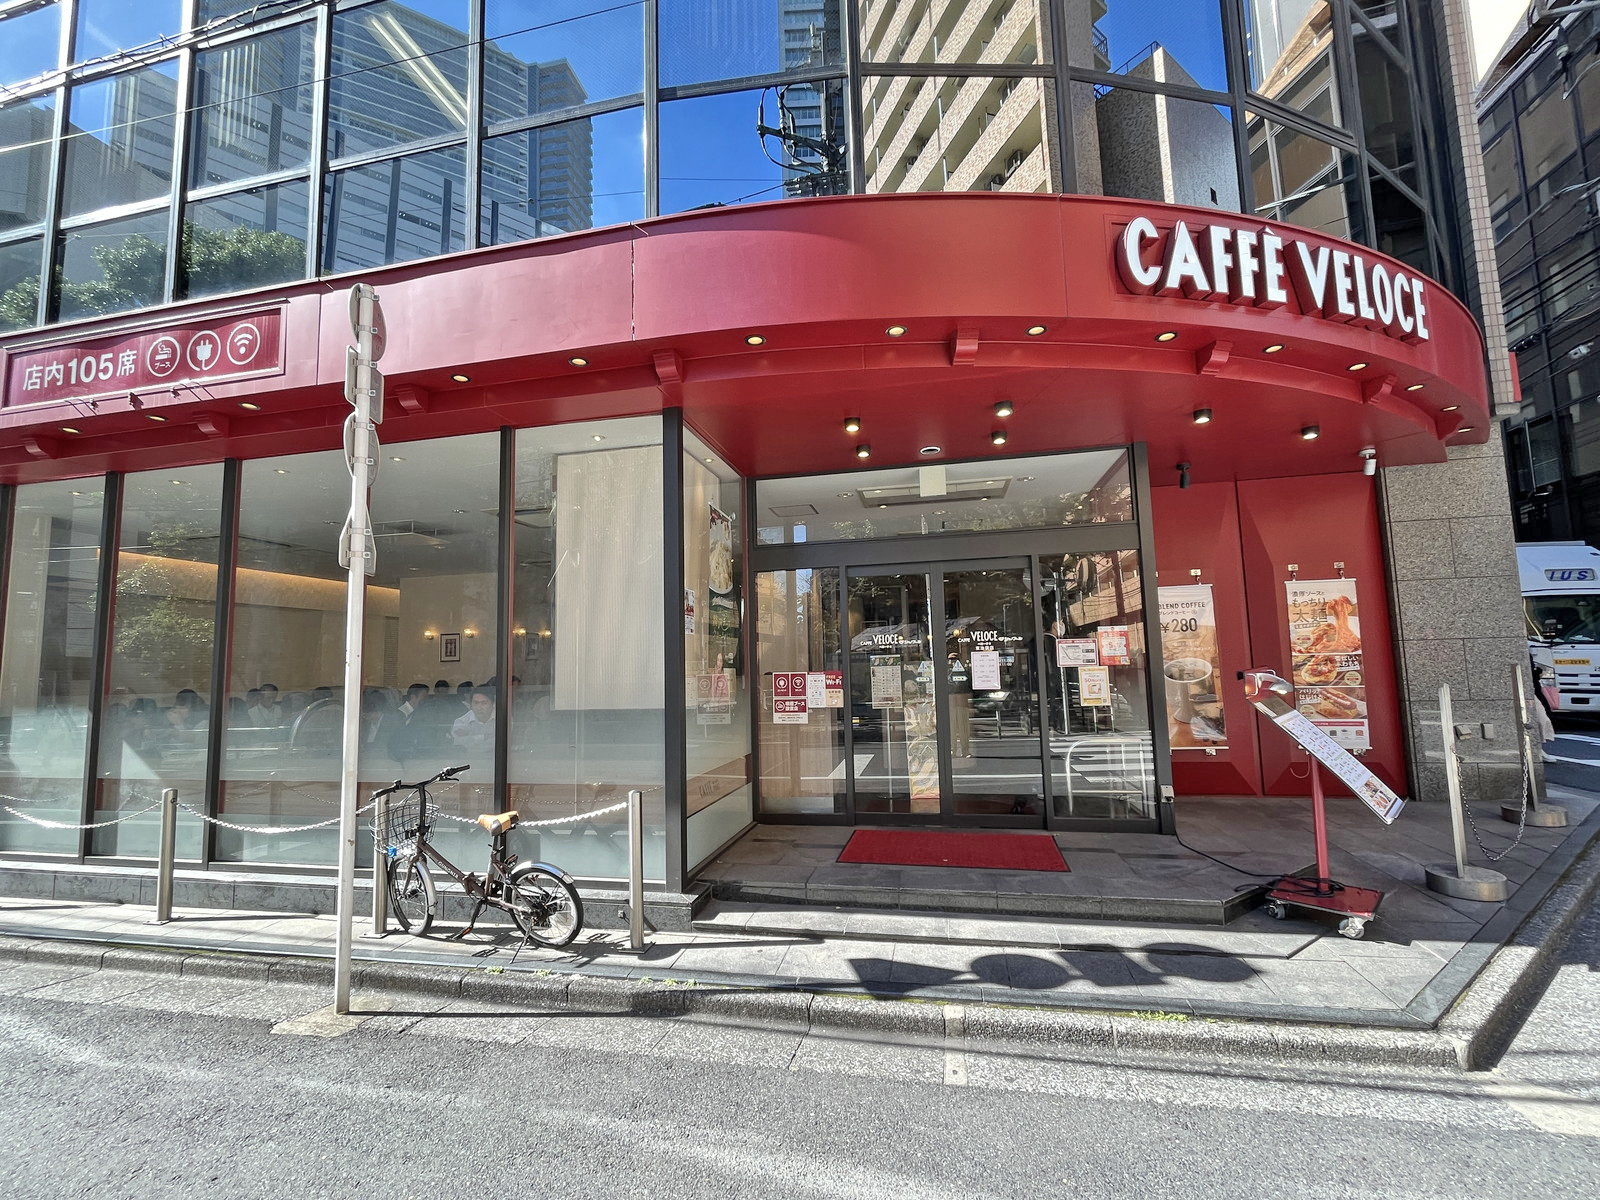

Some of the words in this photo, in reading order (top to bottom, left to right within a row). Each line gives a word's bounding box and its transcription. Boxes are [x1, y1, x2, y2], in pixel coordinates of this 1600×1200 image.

[1123, 216, 1288, 303] CAFFÈ
[1295, 239, 1430, 341] VELOCE
[22, 348, 138, 391] 店内105席
[154, 361, 171, 370] ブース
[1180, 601, 1206, 609] COFFEE
[1292, 597, 1327, 608] もっちり
[1160, 617, 1198, 634] ¥280
[872, 633, 899, 645] VELOCE
[970, 630, 998, 642] VELOCE
